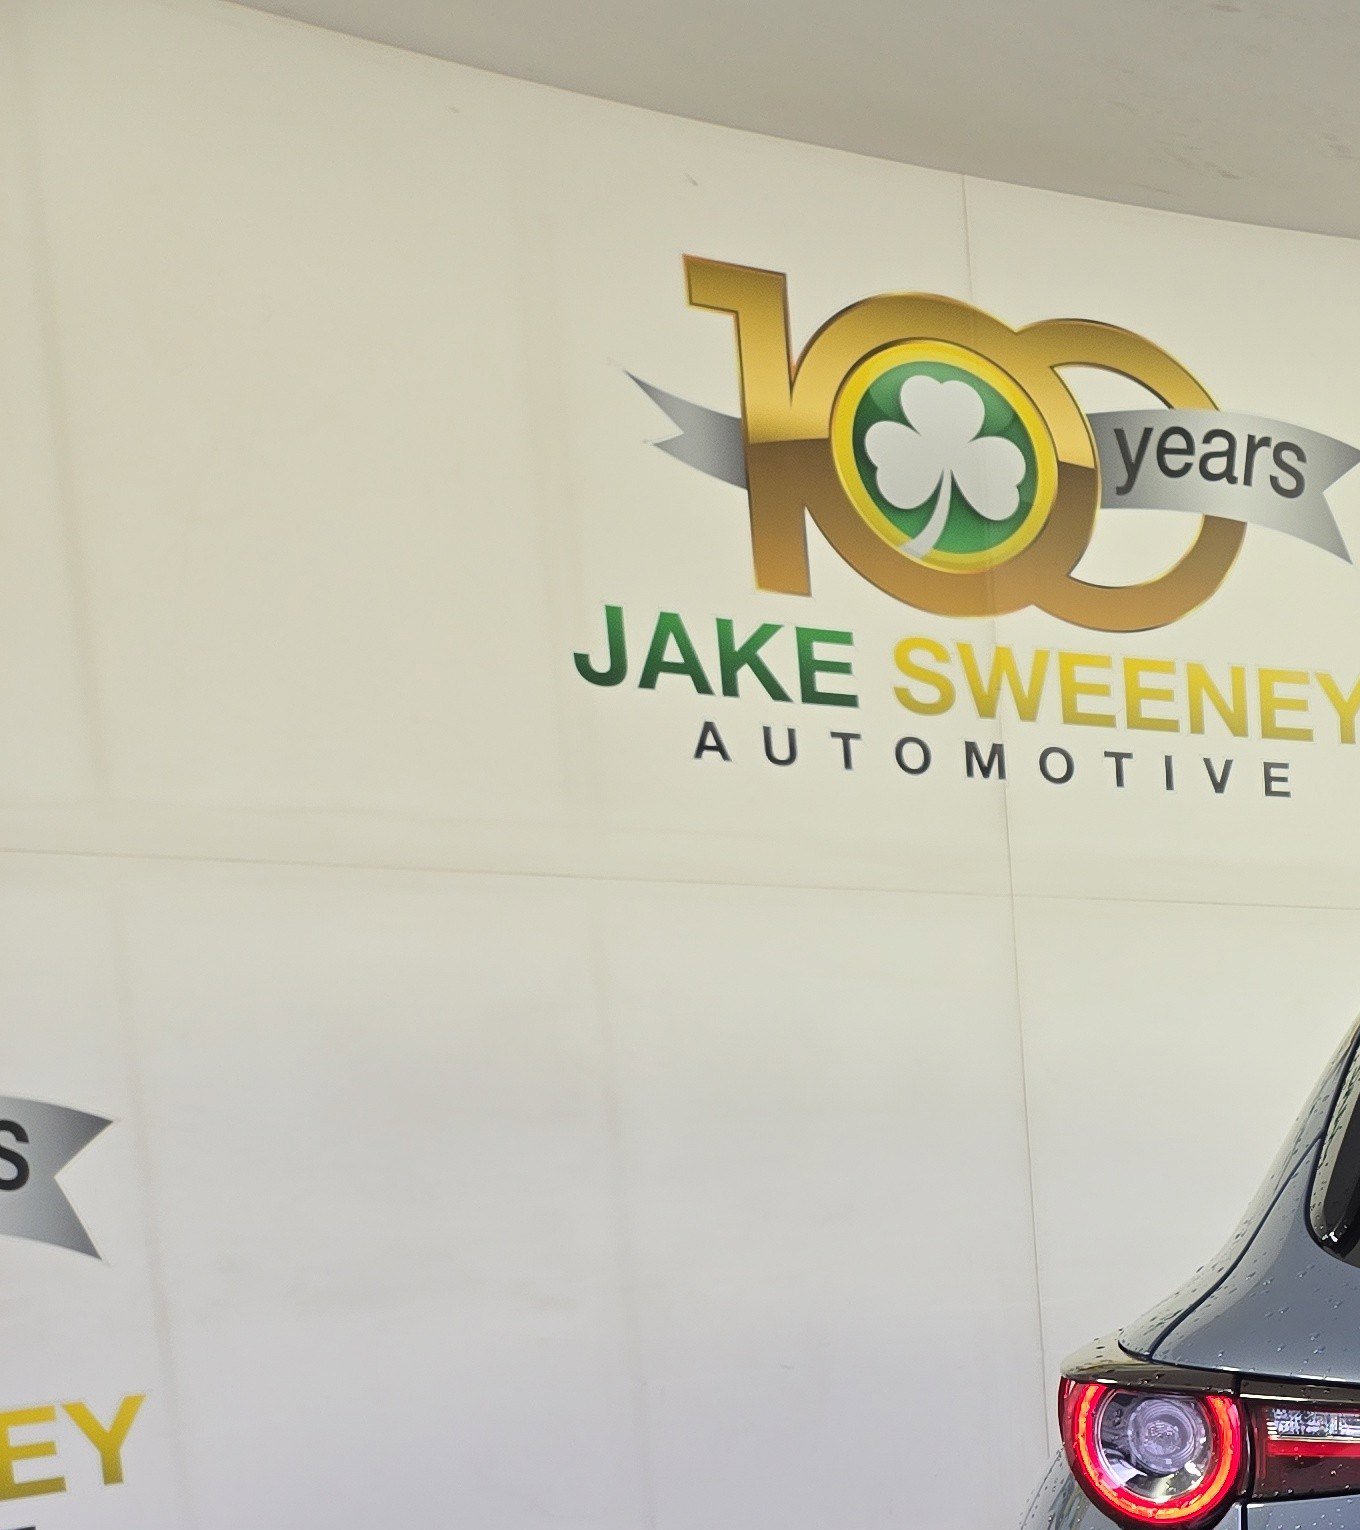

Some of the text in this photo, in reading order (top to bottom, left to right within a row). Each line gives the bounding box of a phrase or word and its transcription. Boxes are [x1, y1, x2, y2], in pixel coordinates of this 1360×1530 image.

[682, 253, 1248, 633] 100
[1113, 423, 1308, 499] years
[573, 604, 860, 709] JAKE
[693, 721, 1293, 799] AUTOMOTIVE
